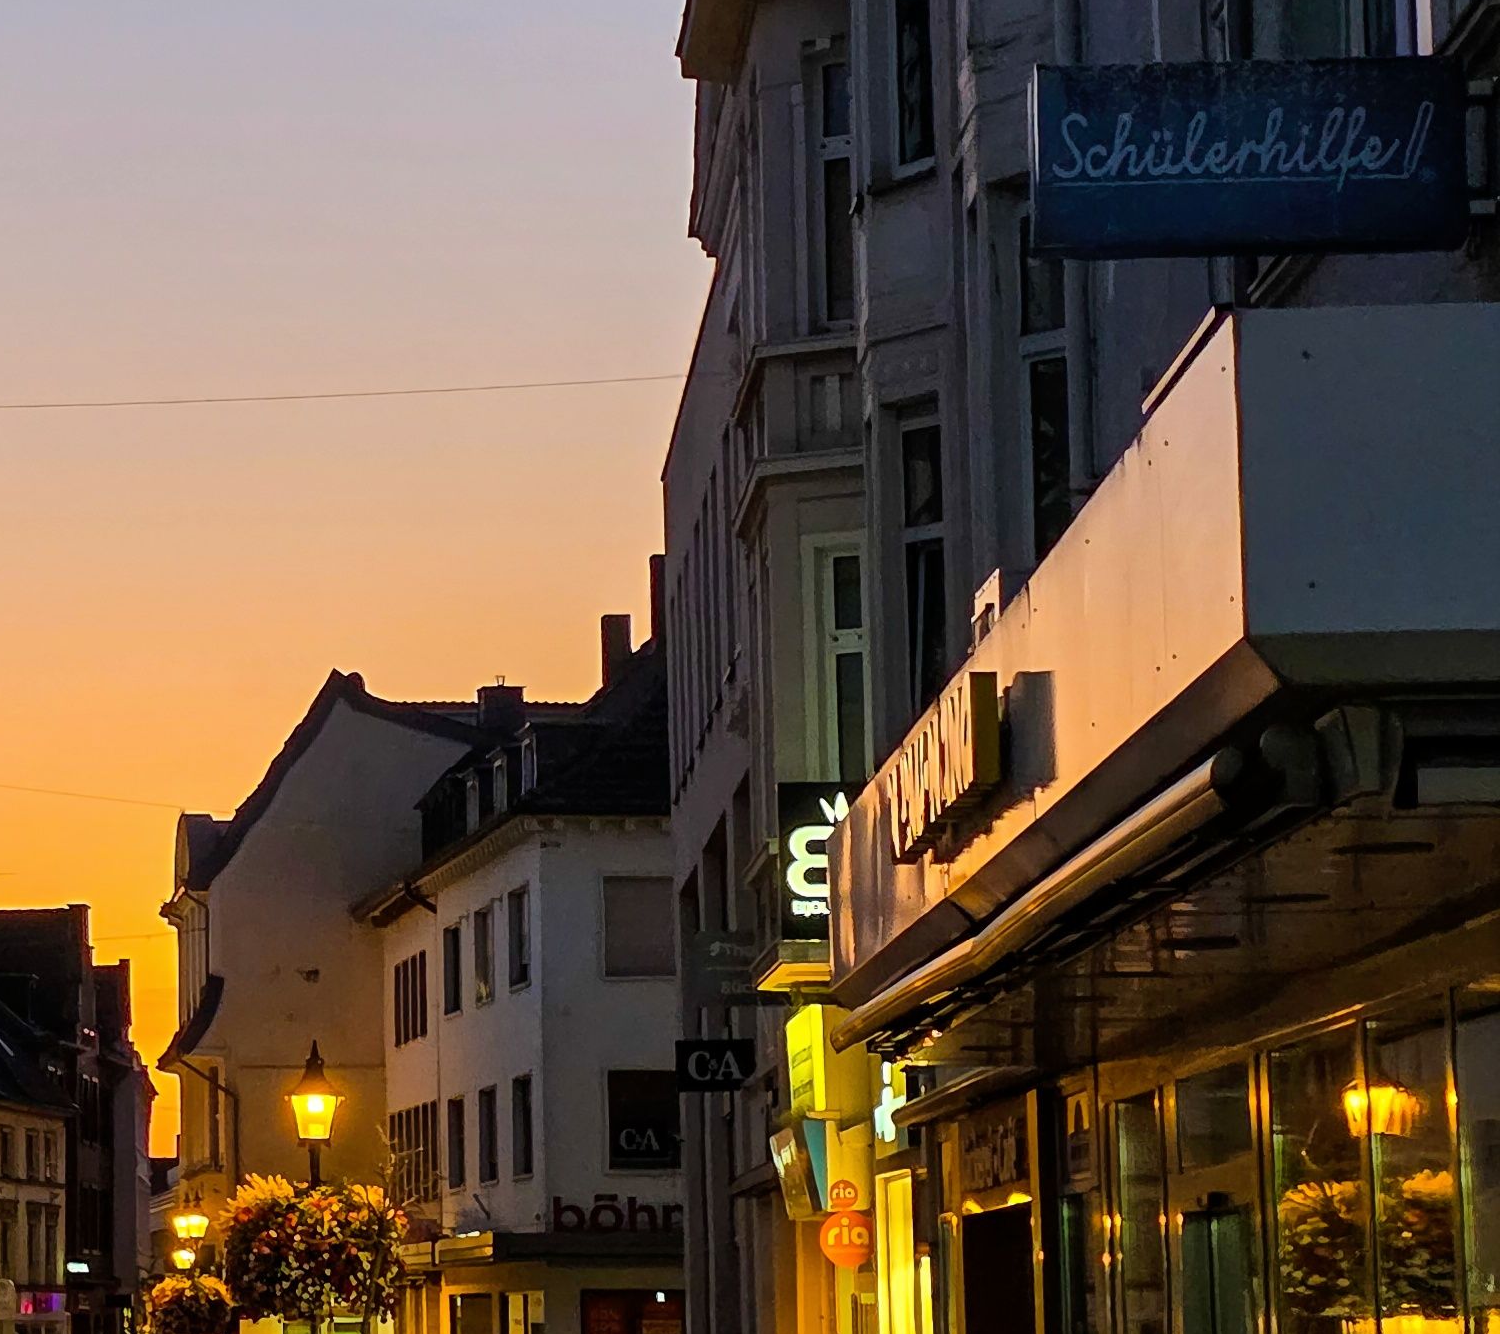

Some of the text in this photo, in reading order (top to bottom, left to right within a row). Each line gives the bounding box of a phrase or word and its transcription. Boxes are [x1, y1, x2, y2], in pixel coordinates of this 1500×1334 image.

[687, 1049, 745, 1081] C&A
[831, 1183, 856, 1200] ria
[826, 1216, 870, 1246] ria
